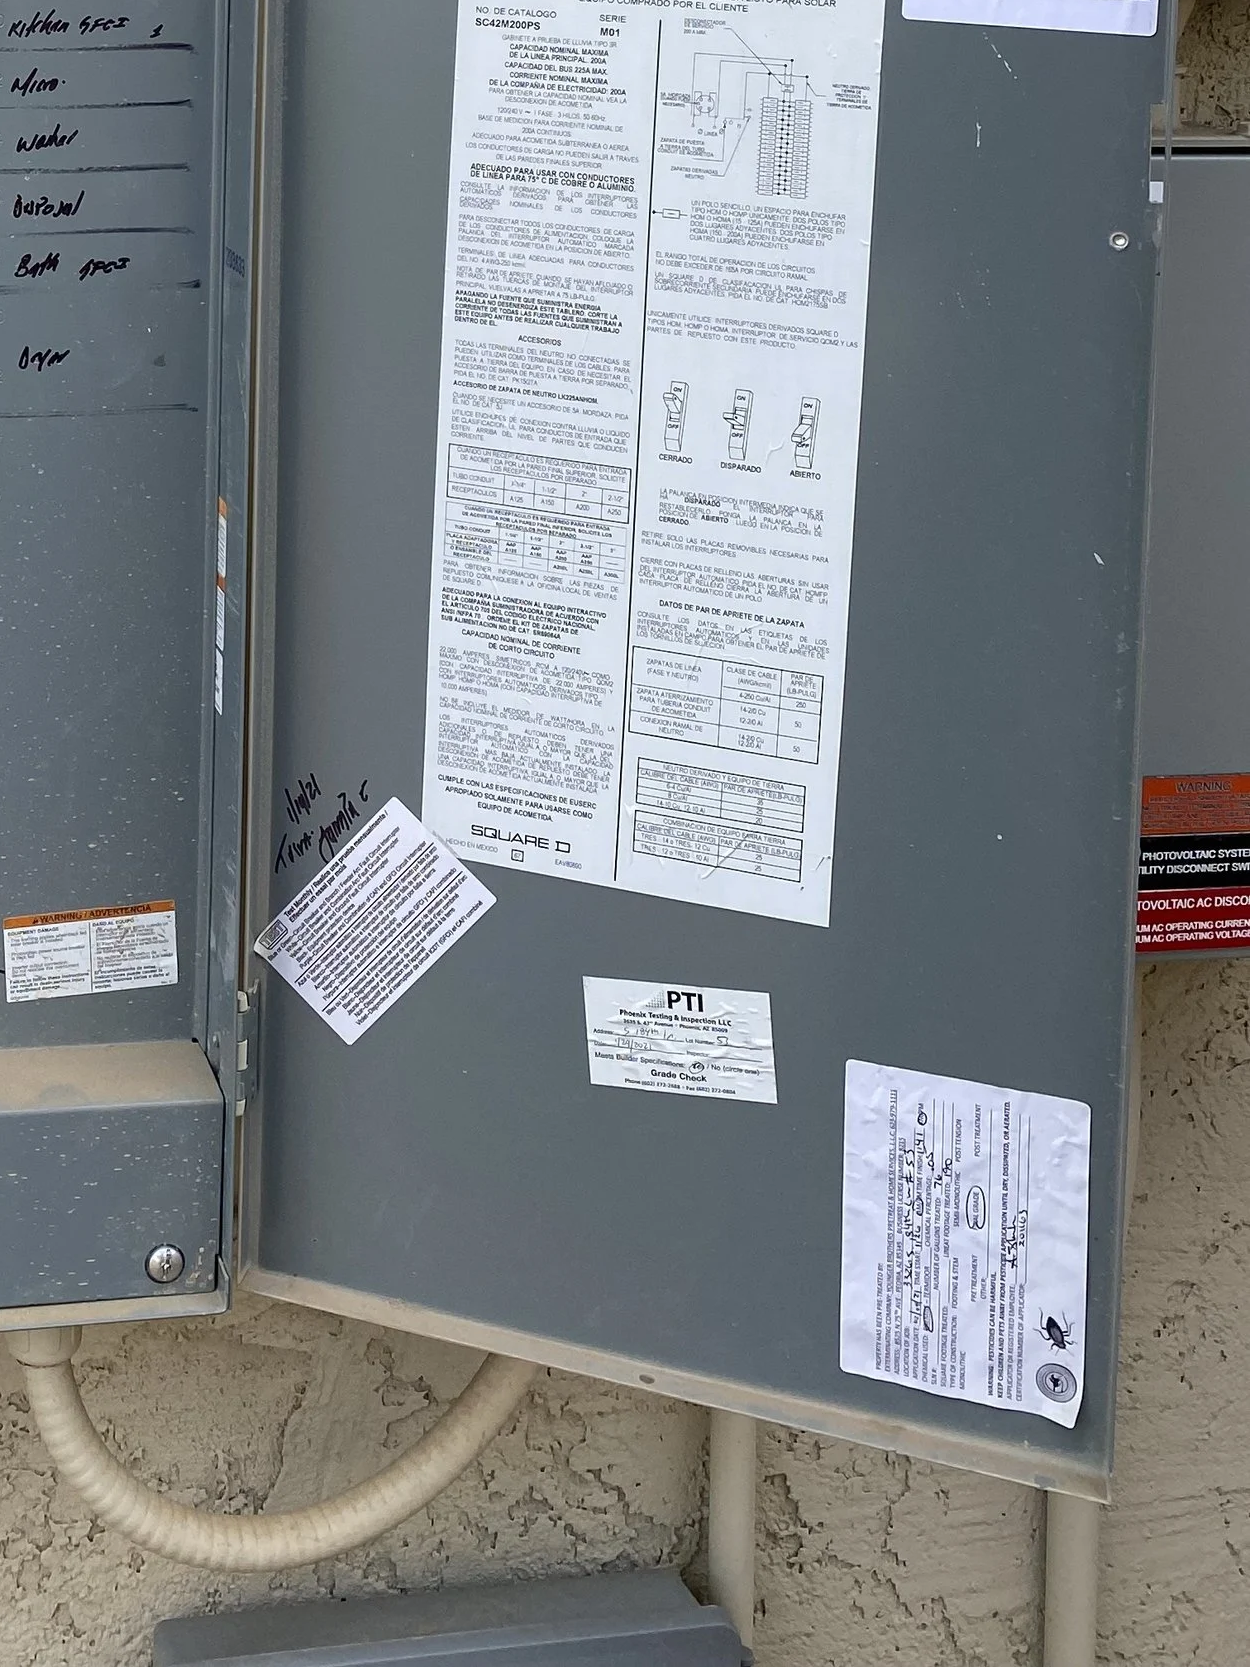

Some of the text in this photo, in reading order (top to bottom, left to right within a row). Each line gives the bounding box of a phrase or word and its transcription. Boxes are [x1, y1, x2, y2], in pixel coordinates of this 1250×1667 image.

[507, 9, 557, 19] CATALOGO
[475, 18, 541, 31] SC42M200PS
[600, 27, 620, 38] M01
[659, 453, 692, 464] CERRADO
[720, 462, 761, 473] DISPARADO
[790, 470, 821, 480] ABIERTO
[1176, 781, 1233, 792] WARNING
[471, 824, 570, 854] SQUARE D
[1143, 850, 1216, 861] PHOTOVOLTAIC
[1167, 863, 1230, 874] DISCONNECT
[1197, 897, 1212, 908] AC
[1166, 921, 1214, 931] OPERATING
[667, 991, 703, 1012] PTI
[651, 1070, 707, 1082] Grade Check
